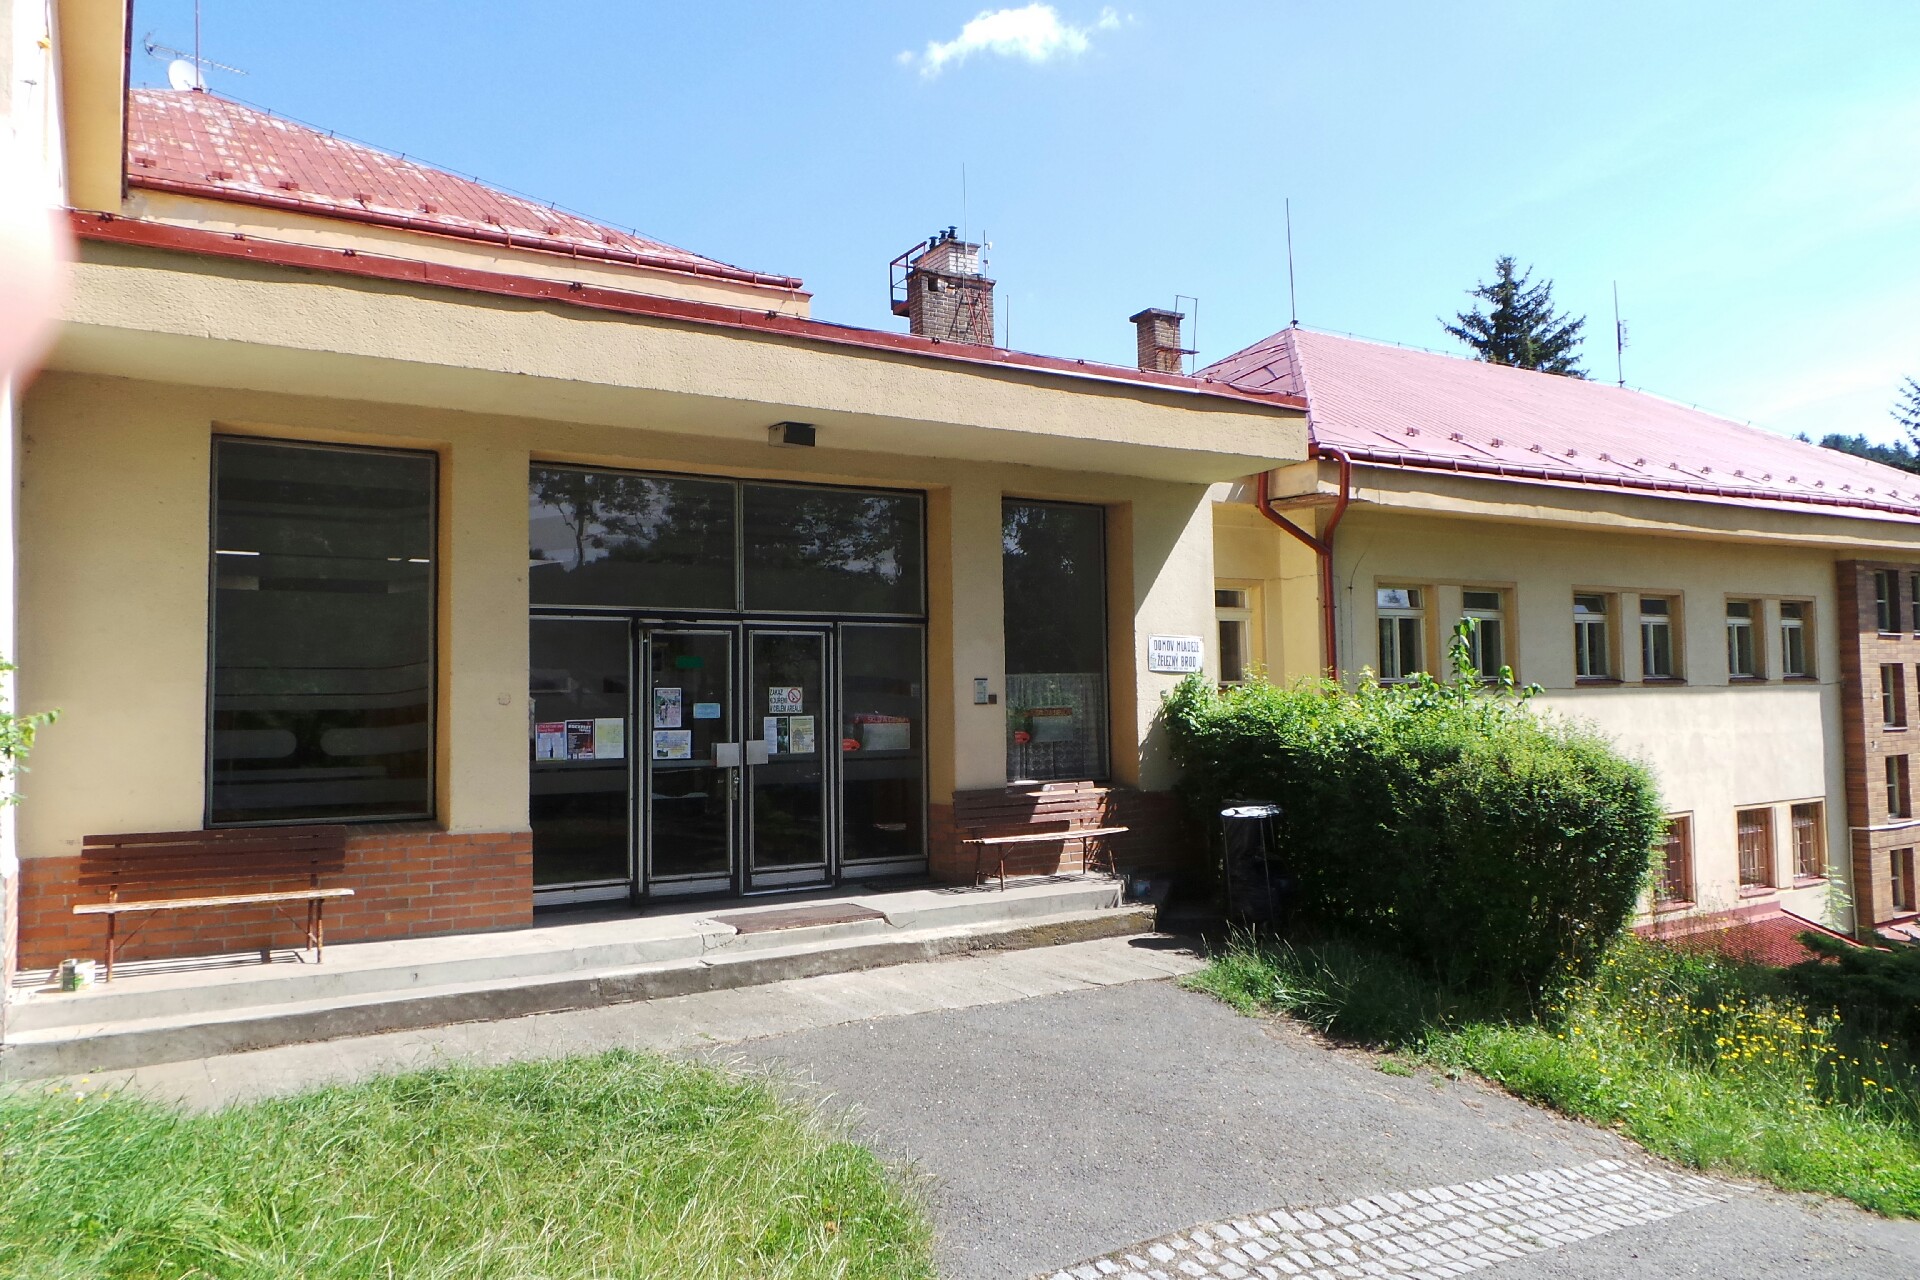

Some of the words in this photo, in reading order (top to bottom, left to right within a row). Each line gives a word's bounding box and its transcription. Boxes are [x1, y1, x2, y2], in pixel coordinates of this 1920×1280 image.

[1154, 640, 1174, 651] DOMOV
[1157, 652, 1179, 667] ŽELEZNÝ
[1181, 656, 1196, 667] BROD
